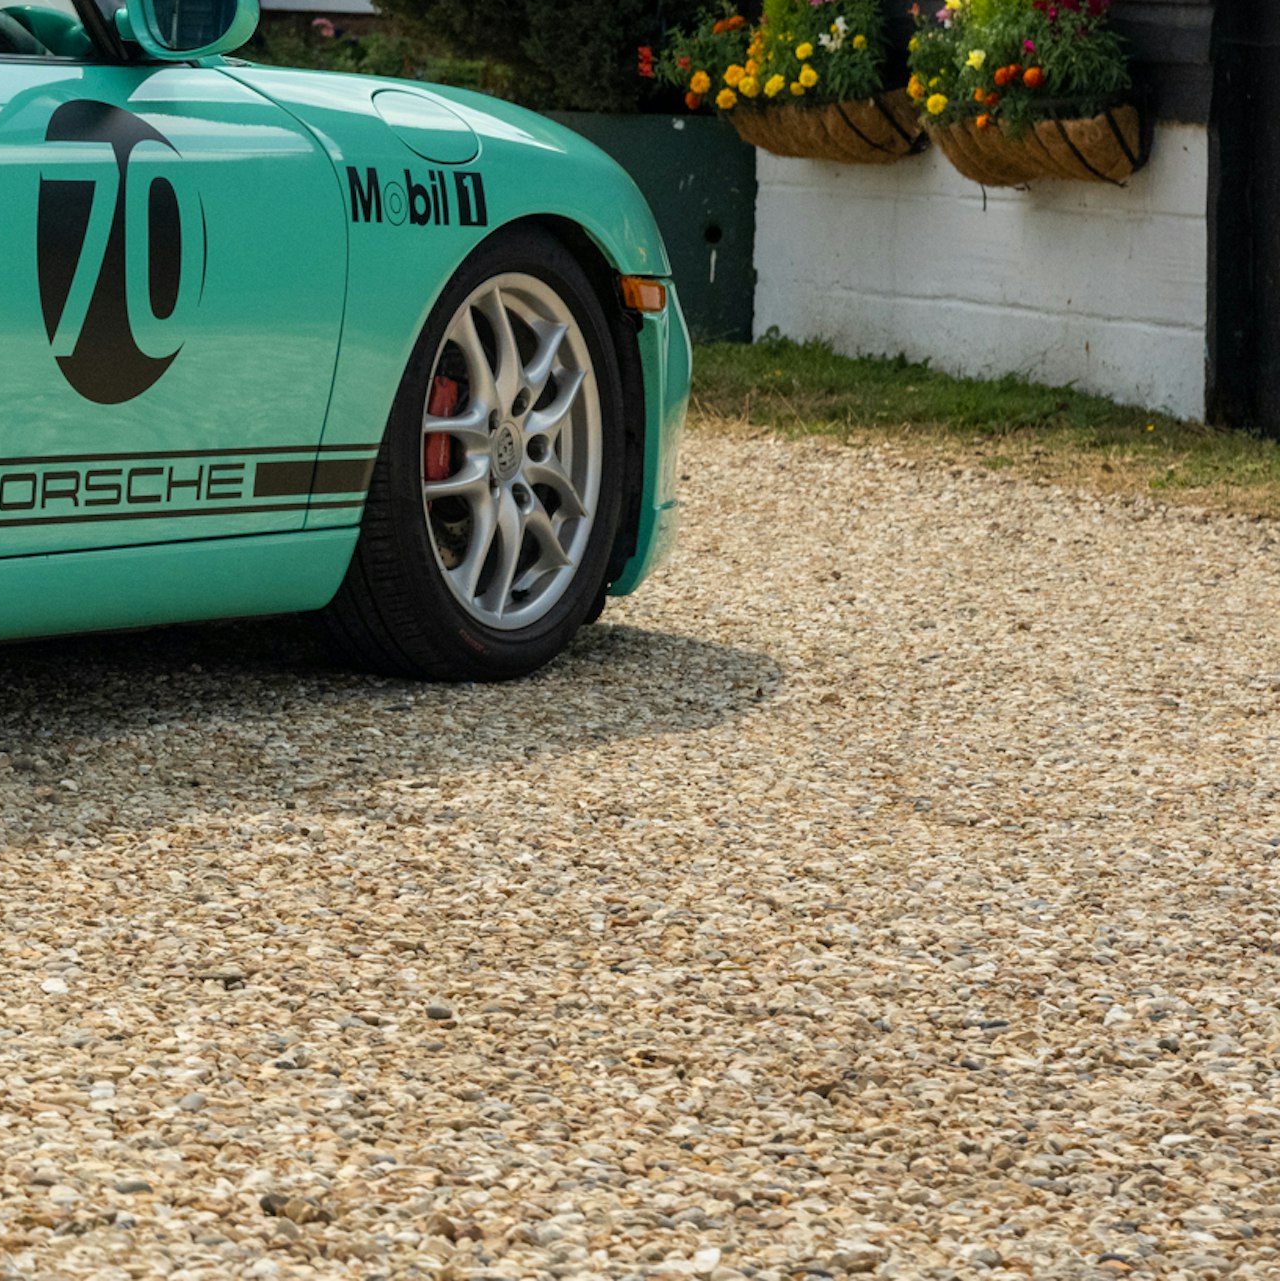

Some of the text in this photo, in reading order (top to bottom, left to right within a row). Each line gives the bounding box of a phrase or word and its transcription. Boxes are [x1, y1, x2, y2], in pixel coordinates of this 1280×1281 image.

[38, 139, 205, 359] 70
[346, 166, 482, 226] Mobil 1
